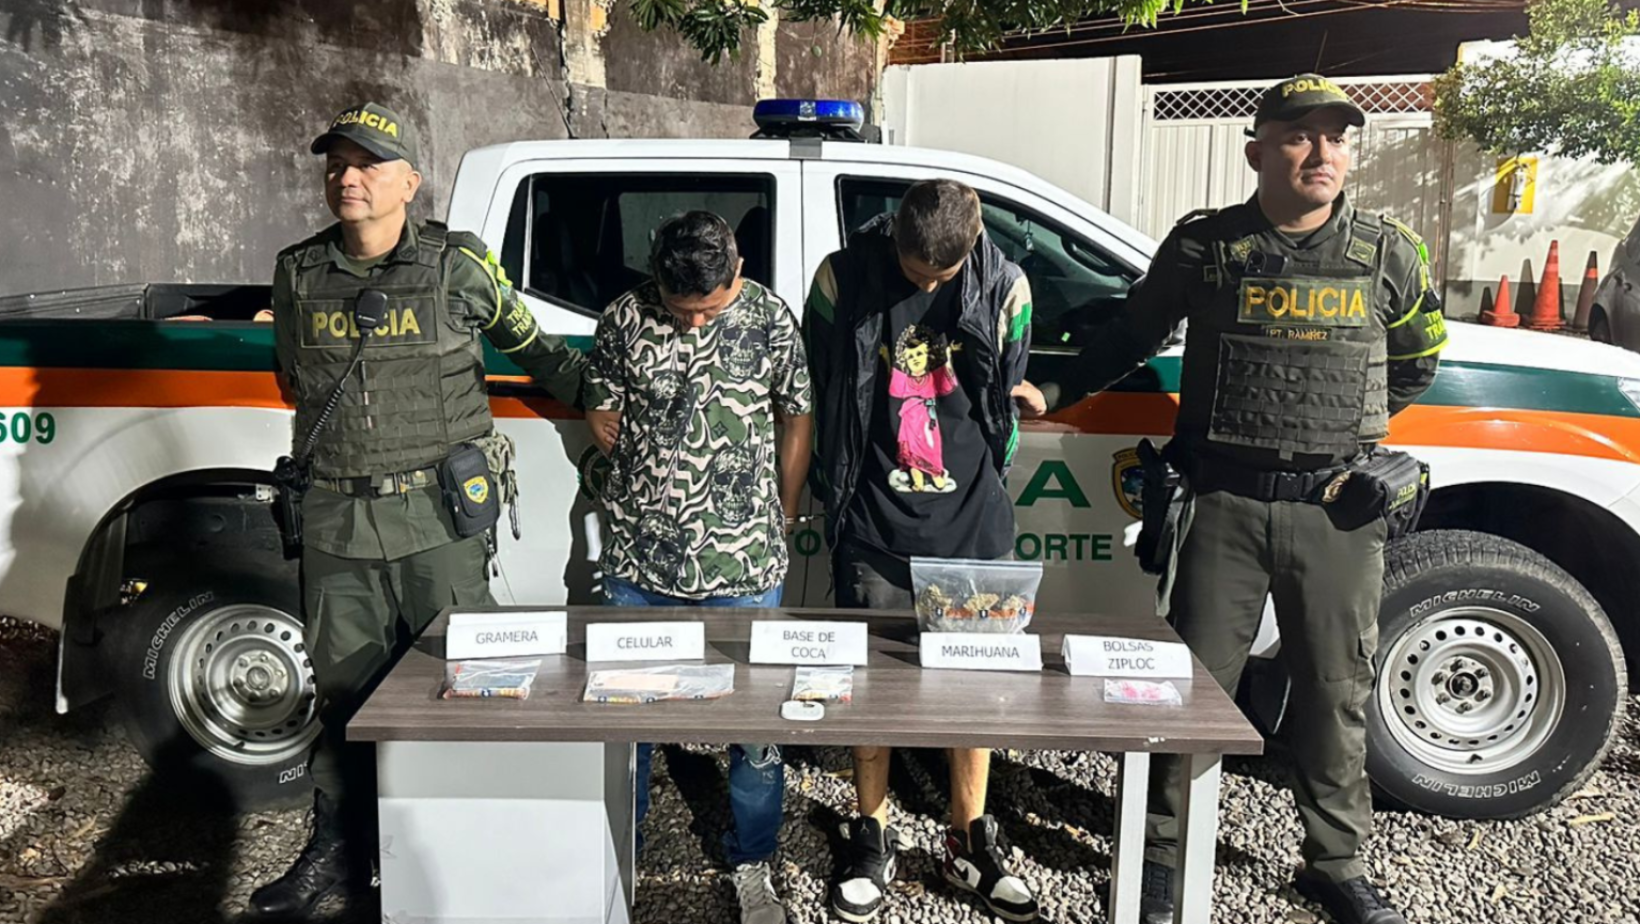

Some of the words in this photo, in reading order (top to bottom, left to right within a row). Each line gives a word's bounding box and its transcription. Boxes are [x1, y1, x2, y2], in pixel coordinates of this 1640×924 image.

[332, 110, 397, 138] POLICIA
[1245, 286, 1366, 318] POLICIA
[312, 308, 421, 338] POLCIA
[1409, 589, 1541, 617] MICHELIN
[143, 591, 215, 679] MICHELIN
[475, 631, 538, 644] GRAMERA
[783, 630, 814, 642] BASE
[818, 631, 835, 643] DE
[617, 636, 673, 649] CELULAR
[1103, 641, 1153, 652] BOLSAS
[791, 647, 826, 659] COCA
[942, 645, 1020, 658] MARIHUANA
[1108, 658, 1155, 670] ZIPLOC
[1411, 770, 1541, 798] MICHELIN
